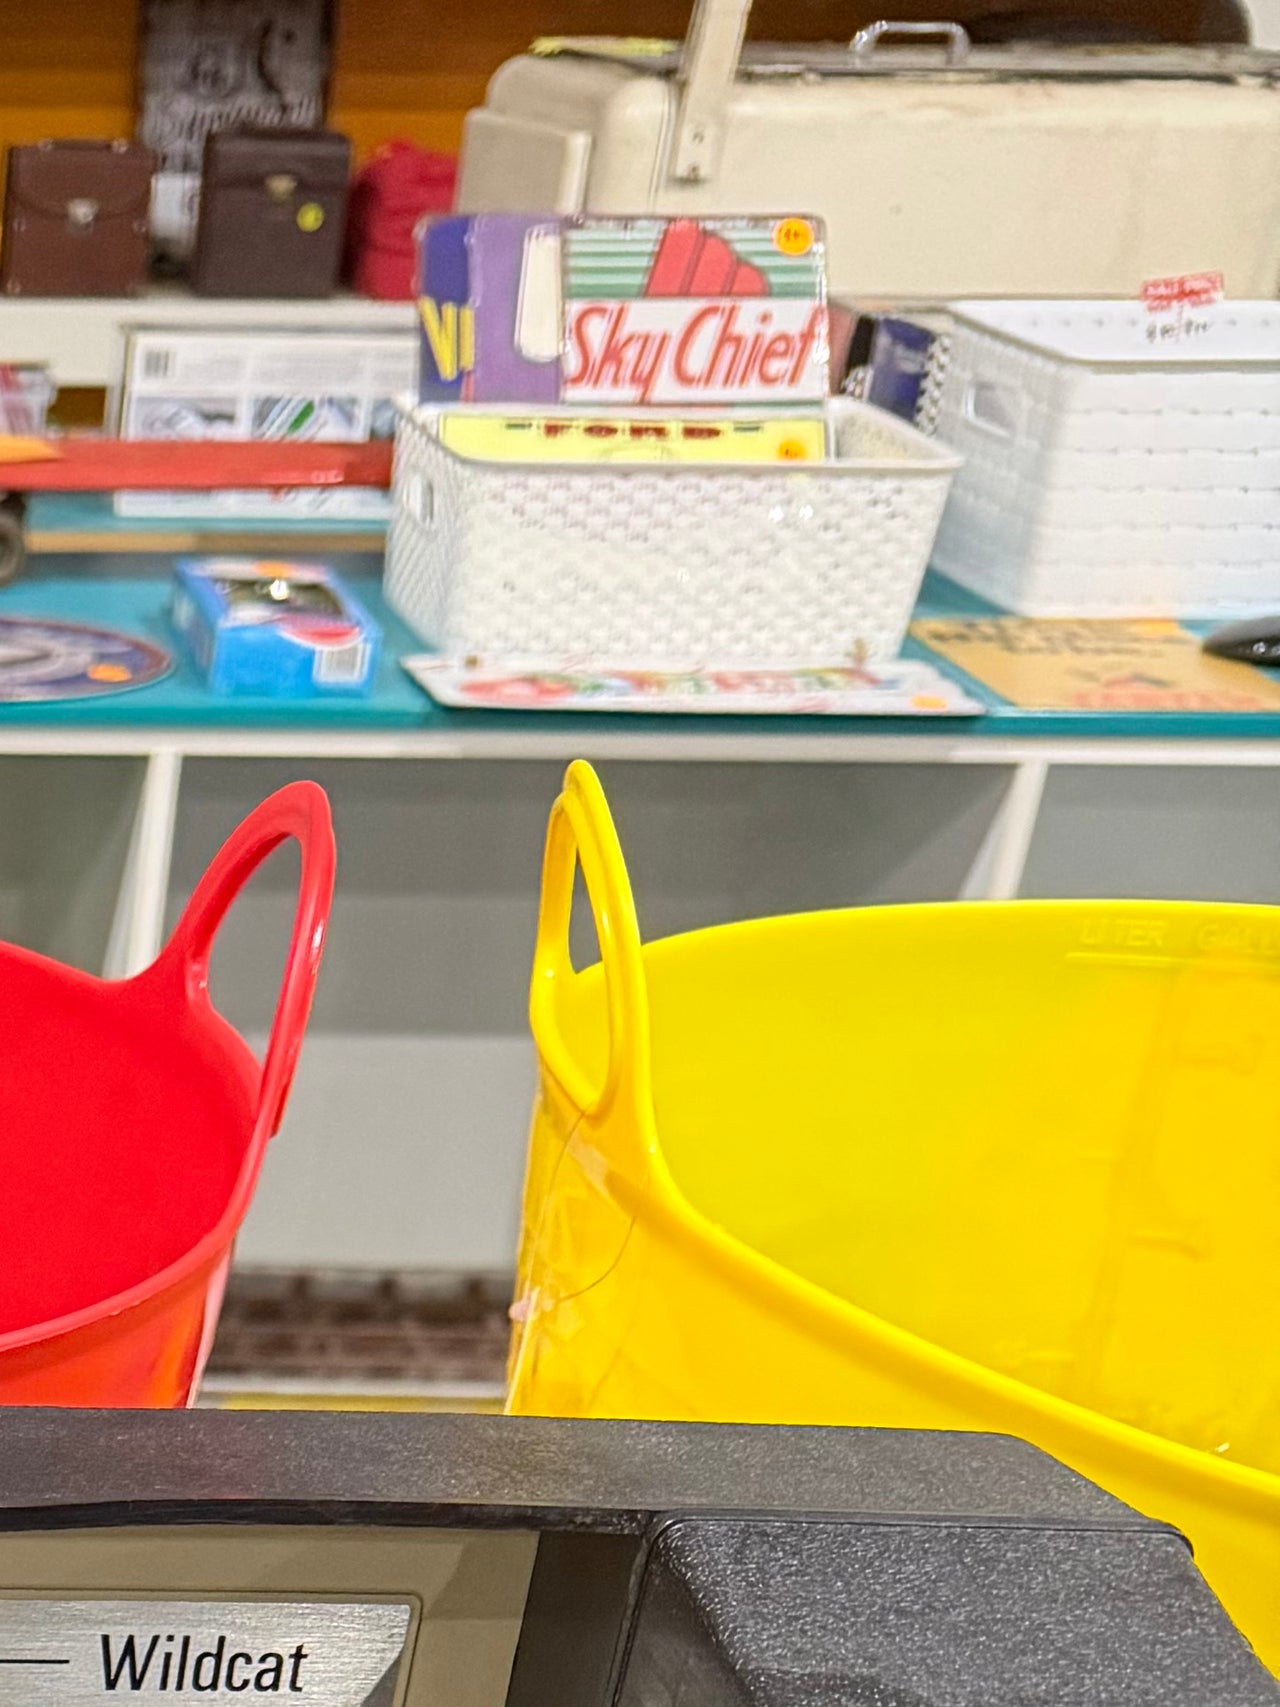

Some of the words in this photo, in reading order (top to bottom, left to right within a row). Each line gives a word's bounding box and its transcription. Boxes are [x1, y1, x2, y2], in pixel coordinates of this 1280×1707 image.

[566, 302, 668, 402] Sky
[673, 303, 828, 388] Chief
[1198, 921, 1280, 955] GALL
[100, 1633, 309, 1693] Wildcat
